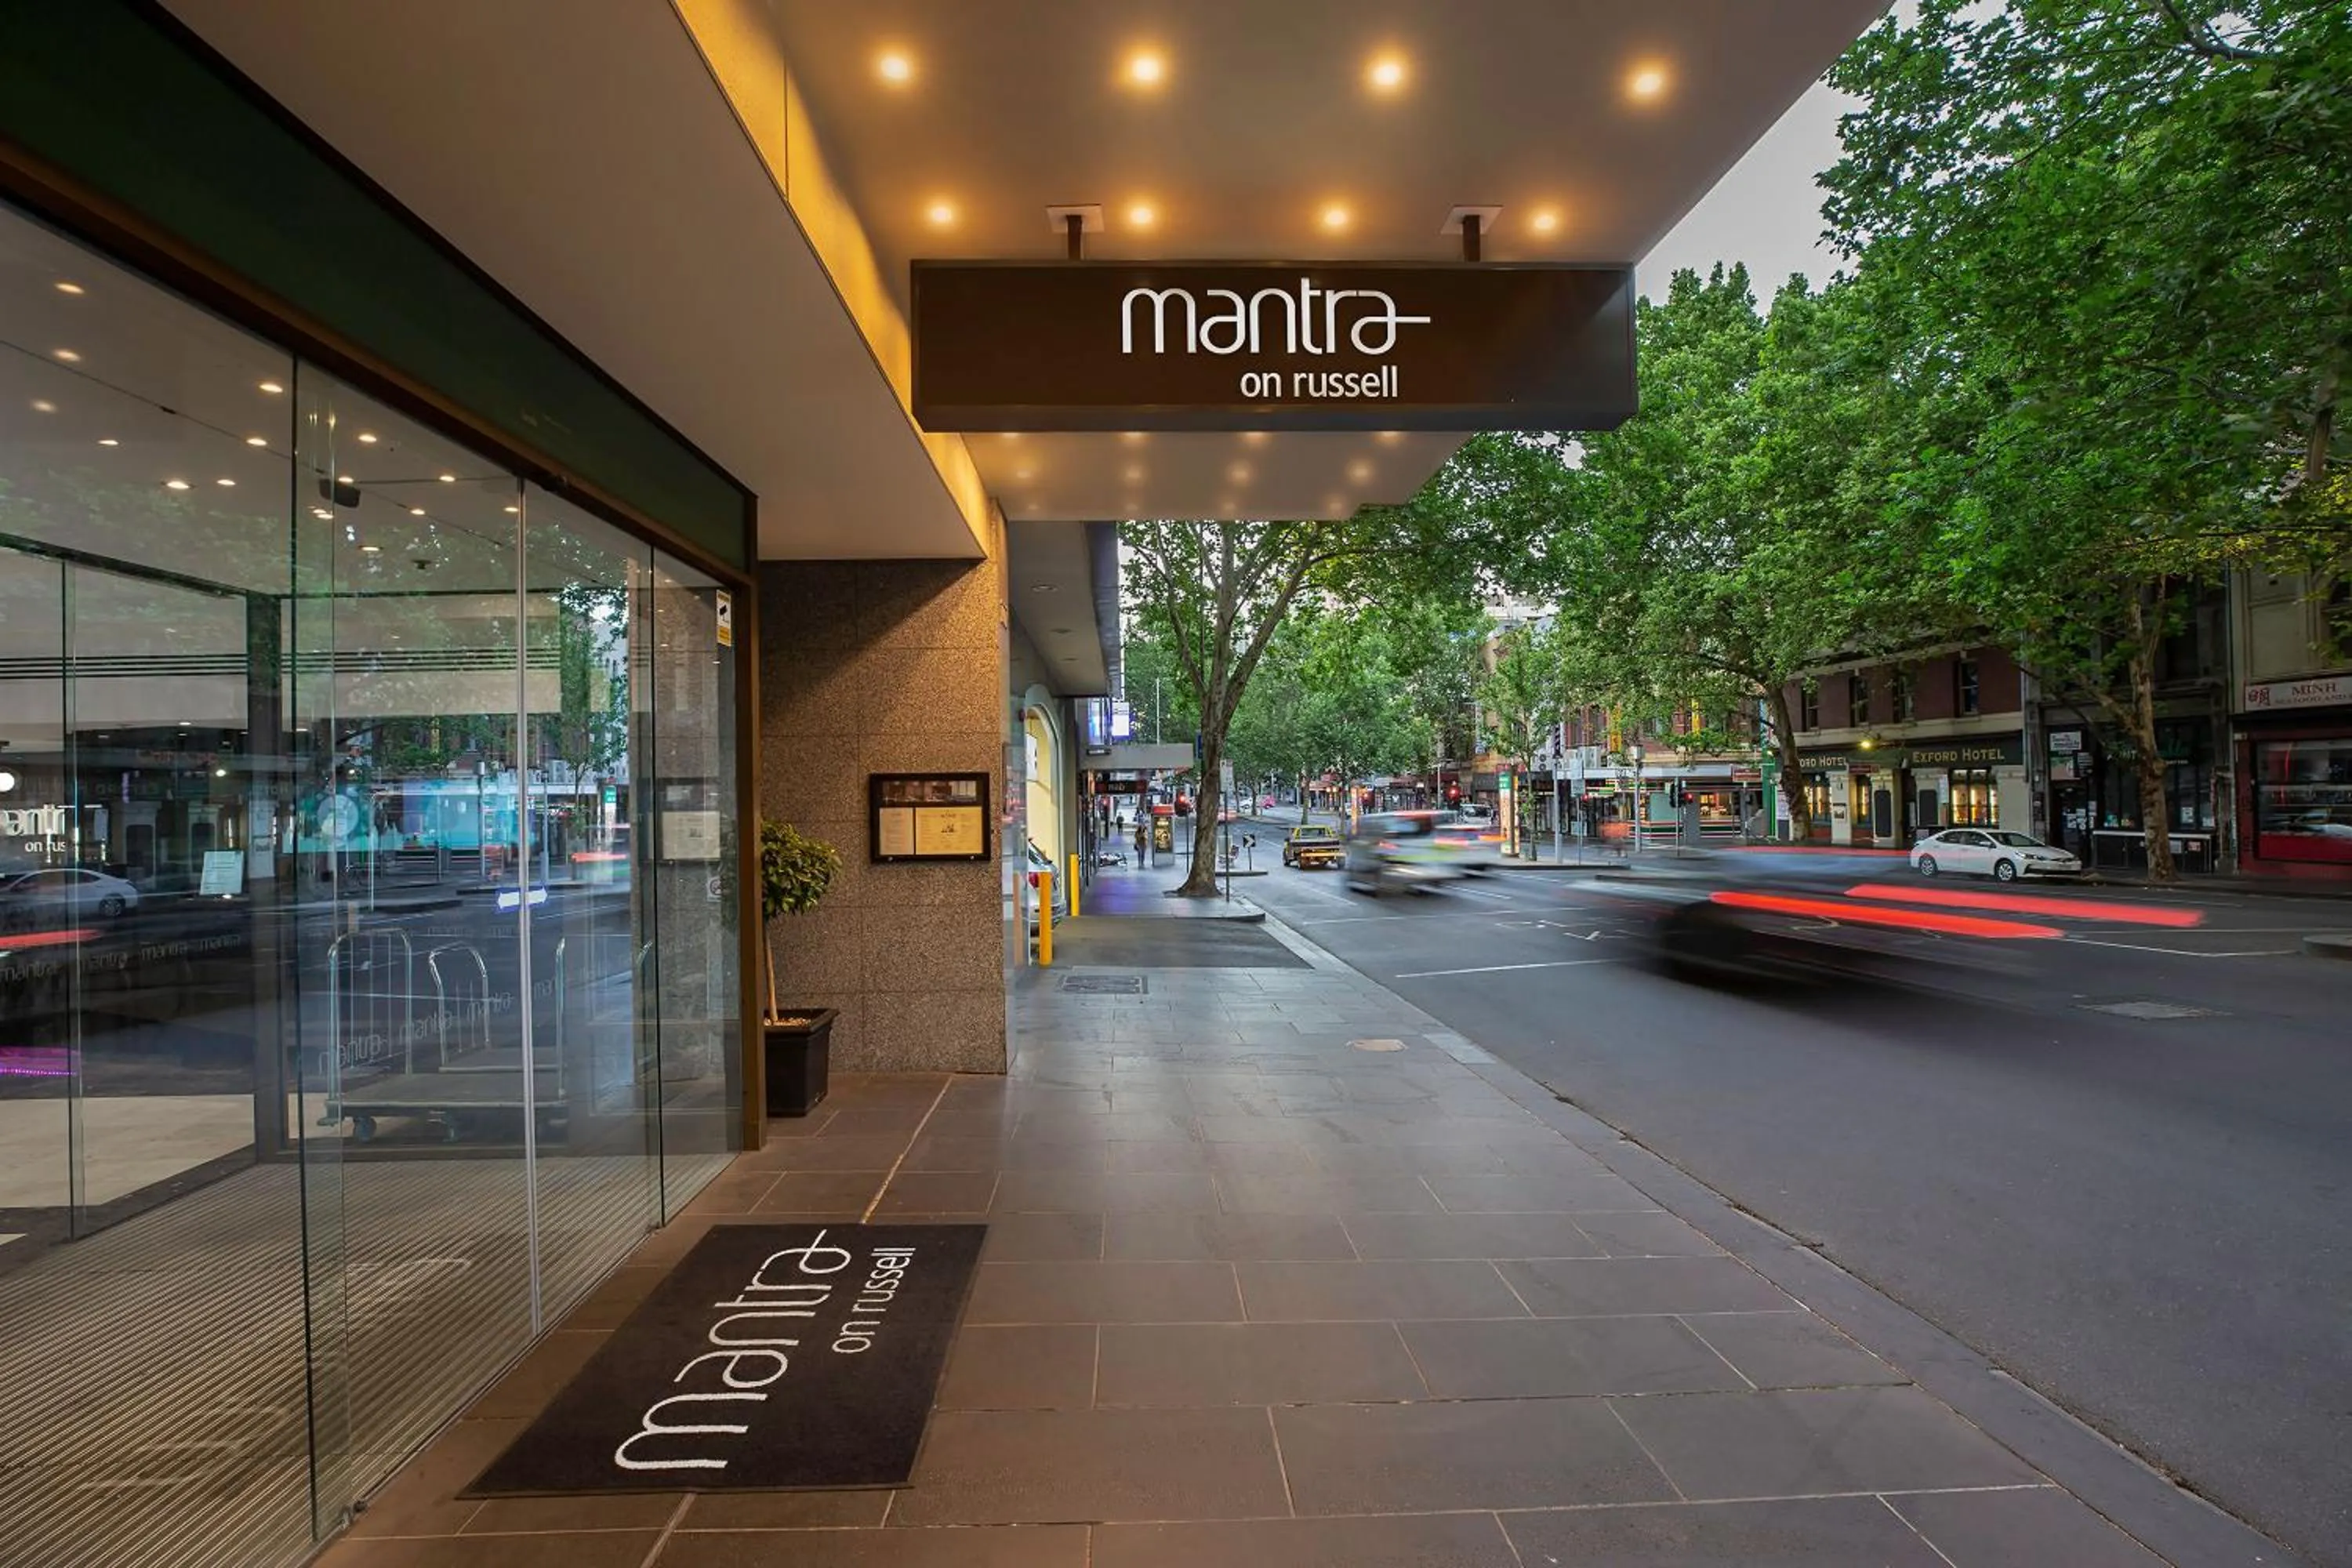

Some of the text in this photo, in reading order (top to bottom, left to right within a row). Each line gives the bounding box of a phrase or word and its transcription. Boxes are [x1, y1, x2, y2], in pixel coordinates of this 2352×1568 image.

[1121, 277, 1432, 356] mantra
[1240, 365, 1398, 398] on russell
[2292, 682, 2336, 696] MINH
[1911, 747, 2005, 764] EXFORD HOTEL
[25, 840, 43, 852] on
[832, 1246, 916, 1355] on russell
[614, 1229, 852, 1471] mantra
